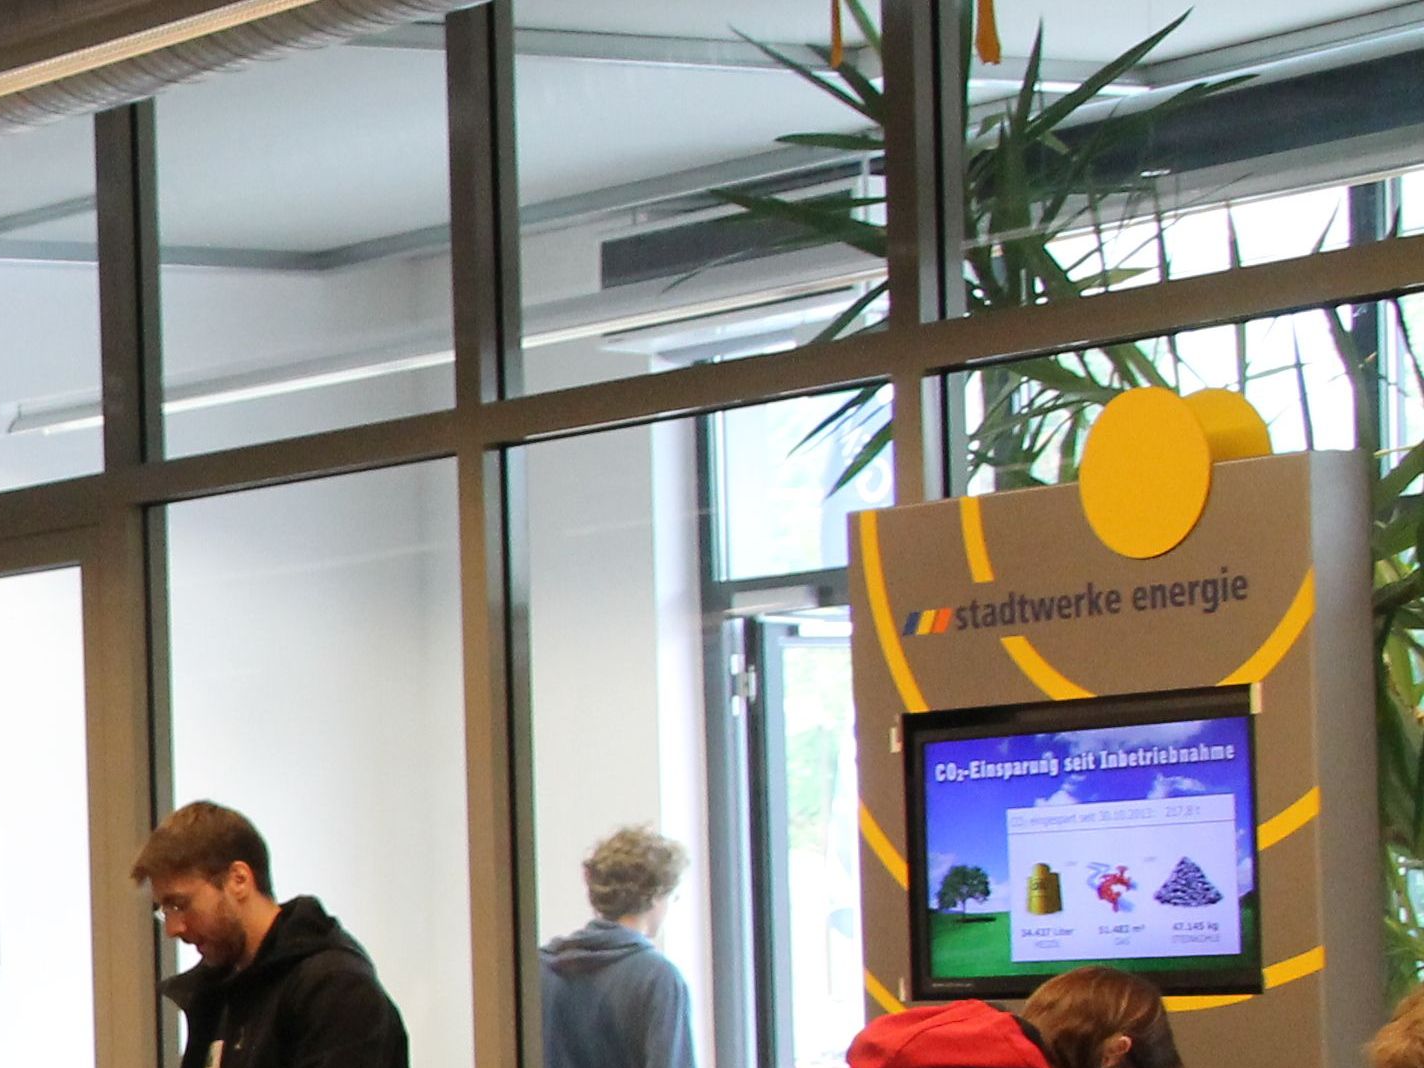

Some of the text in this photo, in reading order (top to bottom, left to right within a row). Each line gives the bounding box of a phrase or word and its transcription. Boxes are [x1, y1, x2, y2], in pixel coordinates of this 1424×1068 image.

[955, 566, 1248, 630] stadtwerke energie
[1064, 755, 1095, 773] seit
[1100, 743, 1235, 770] Inbetriebnahme
